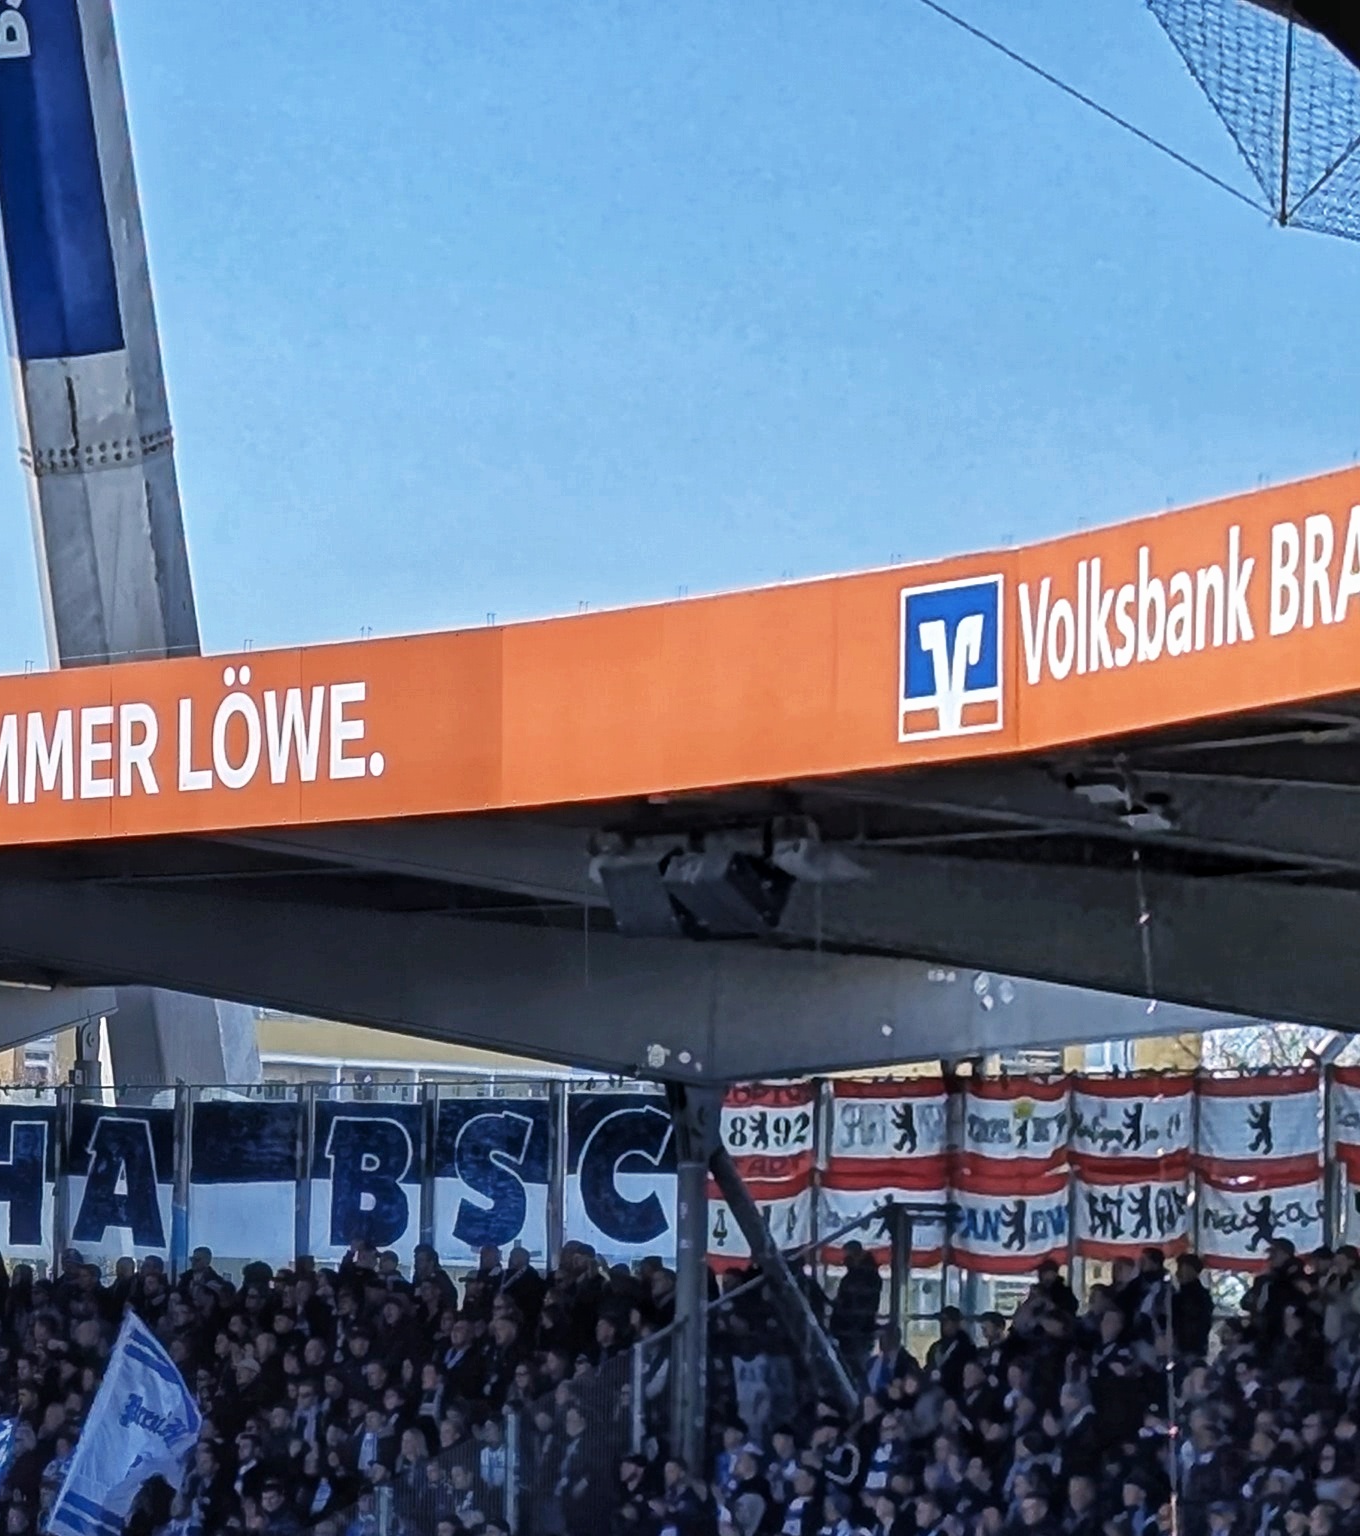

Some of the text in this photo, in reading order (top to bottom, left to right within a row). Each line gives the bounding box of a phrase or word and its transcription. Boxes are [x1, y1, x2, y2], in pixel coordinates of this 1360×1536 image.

[1018, 525, 1255, 686] Volksbank
[178, 665, 385, 793] LÖWE.
[325, 1107, 673, 1248] BSC
